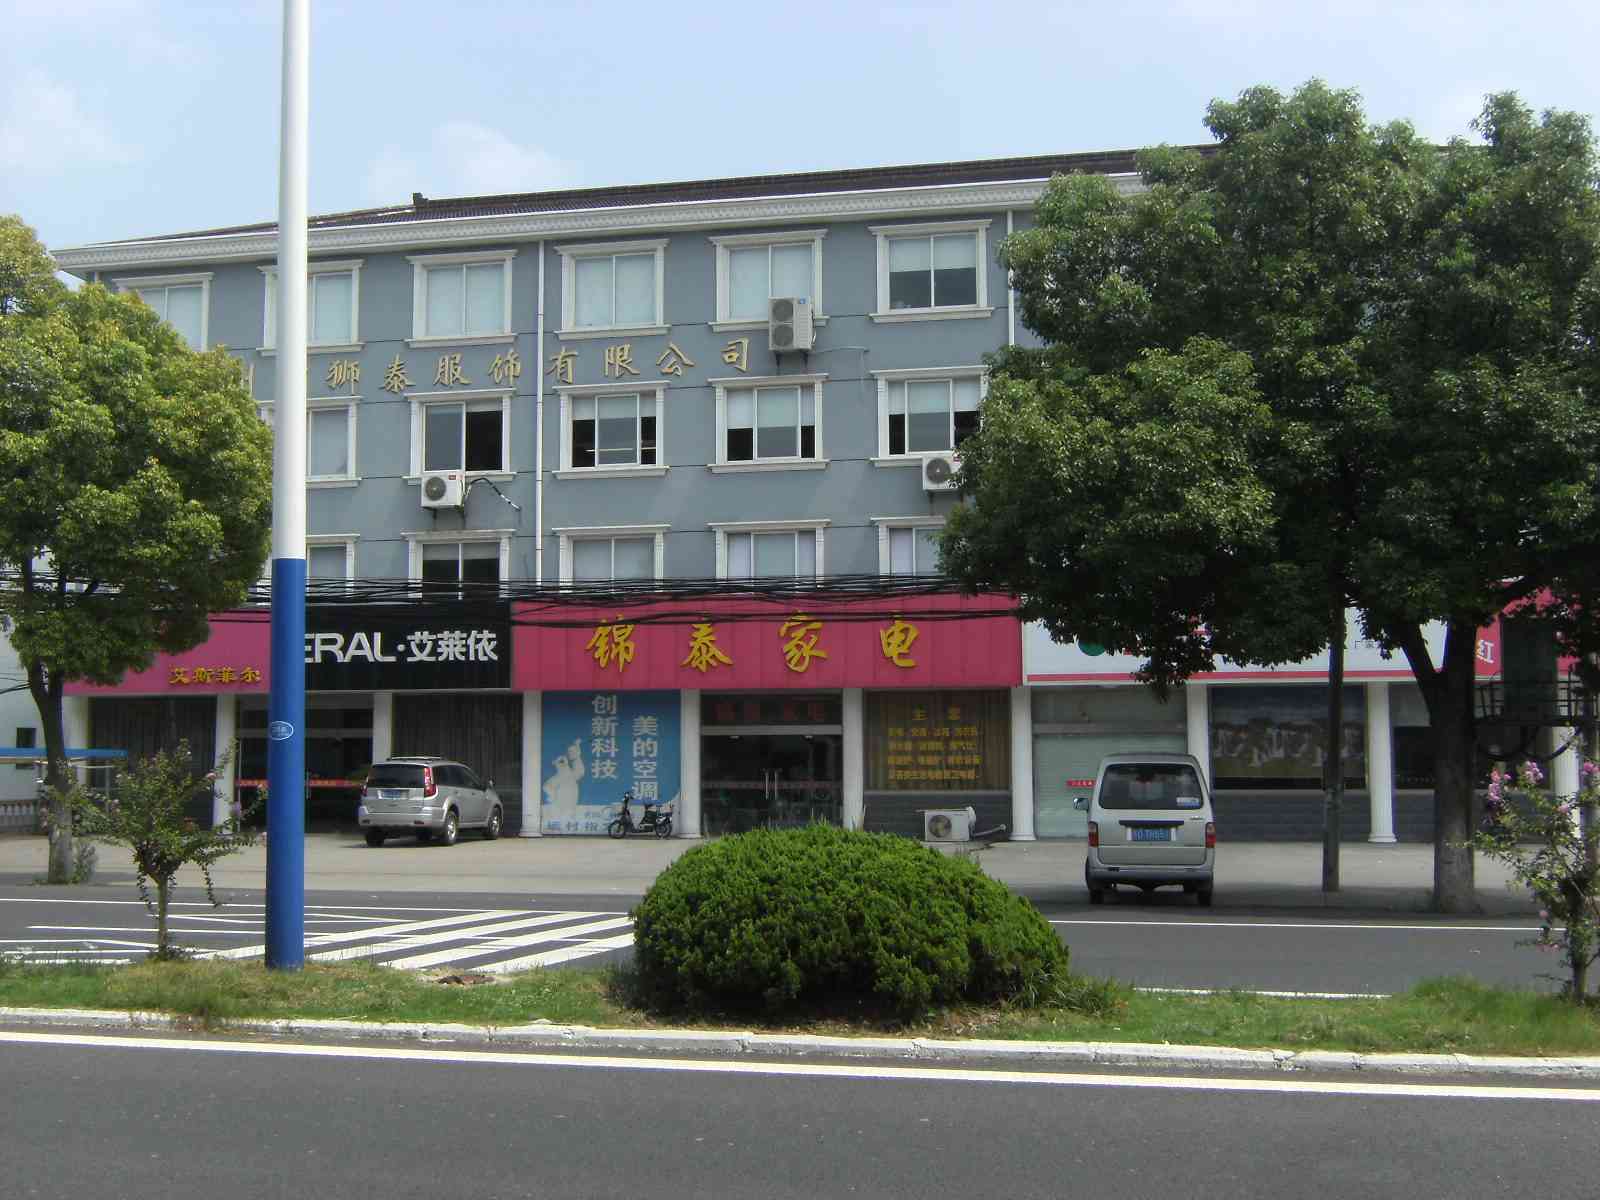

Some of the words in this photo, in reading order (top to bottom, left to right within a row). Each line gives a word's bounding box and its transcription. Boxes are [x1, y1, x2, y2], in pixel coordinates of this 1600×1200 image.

[326, 337, 753, 395] 狮泰服饰有限公司
[585, 609, 921, 674] 锦泰家电
[591, 694, 619, 779] 创新科技
[632, 715, 660, 801] 美的空调
